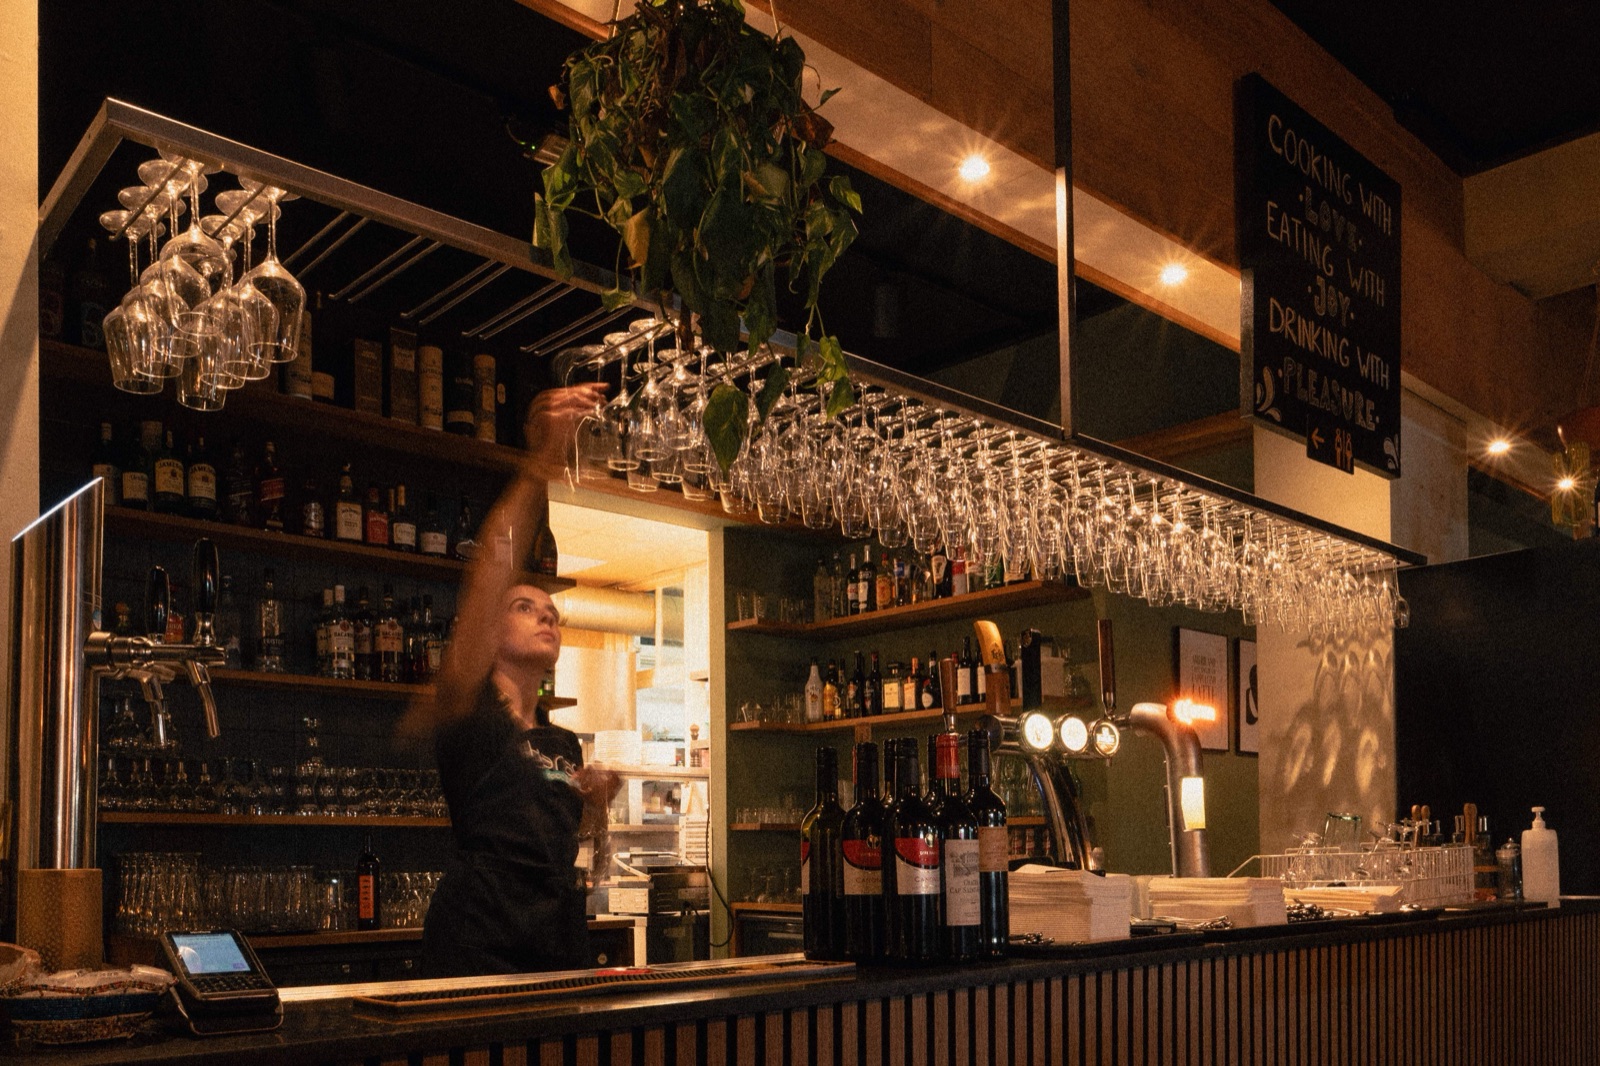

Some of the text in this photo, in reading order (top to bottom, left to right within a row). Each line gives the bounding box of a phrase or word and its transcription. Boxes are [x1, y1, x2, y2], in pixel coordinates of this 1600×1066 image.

[1267, 113, 1392, 237] COOKING WITH
[1266, 200, 1385, 307] EATING WITH
[1304, 185, 1358, 252] LOVE
[1268, 296, 1390, 391] DRINKING WITH
[1313, 275, 1351, 328] JOY
[1282, 356, 1376, 433] PLEASURE
